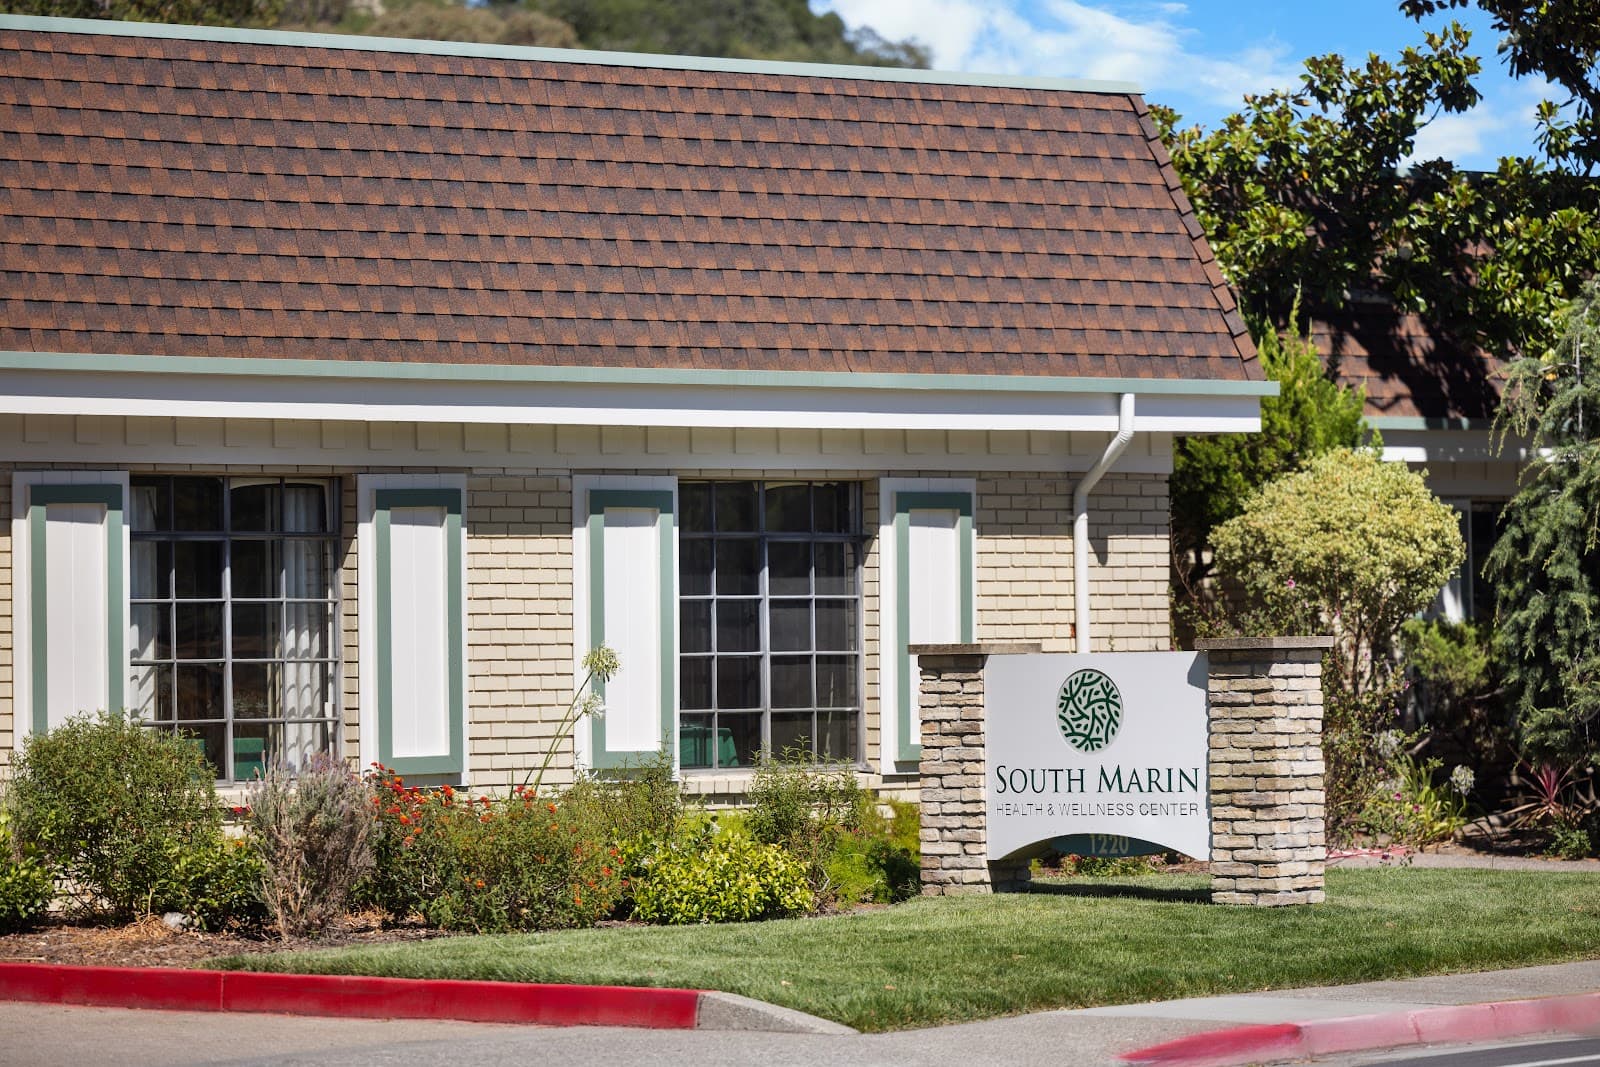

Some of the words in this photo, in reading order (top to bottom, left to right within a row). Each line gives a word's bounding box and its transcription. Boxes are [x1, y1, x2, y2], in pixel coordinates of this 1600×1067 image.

[996, 765, 1086, 794] SOUTH
[1097, 764, 1200, 794] MARIN
[996, 803, 1043, 816] HEALTH
[1048, 803, 1056, 816] &
[1059, 803, 1134, 816] WELLNESS
[1139, 802, 1199, 816] CENTER
[1089, 833, 1129, 854] 1220
